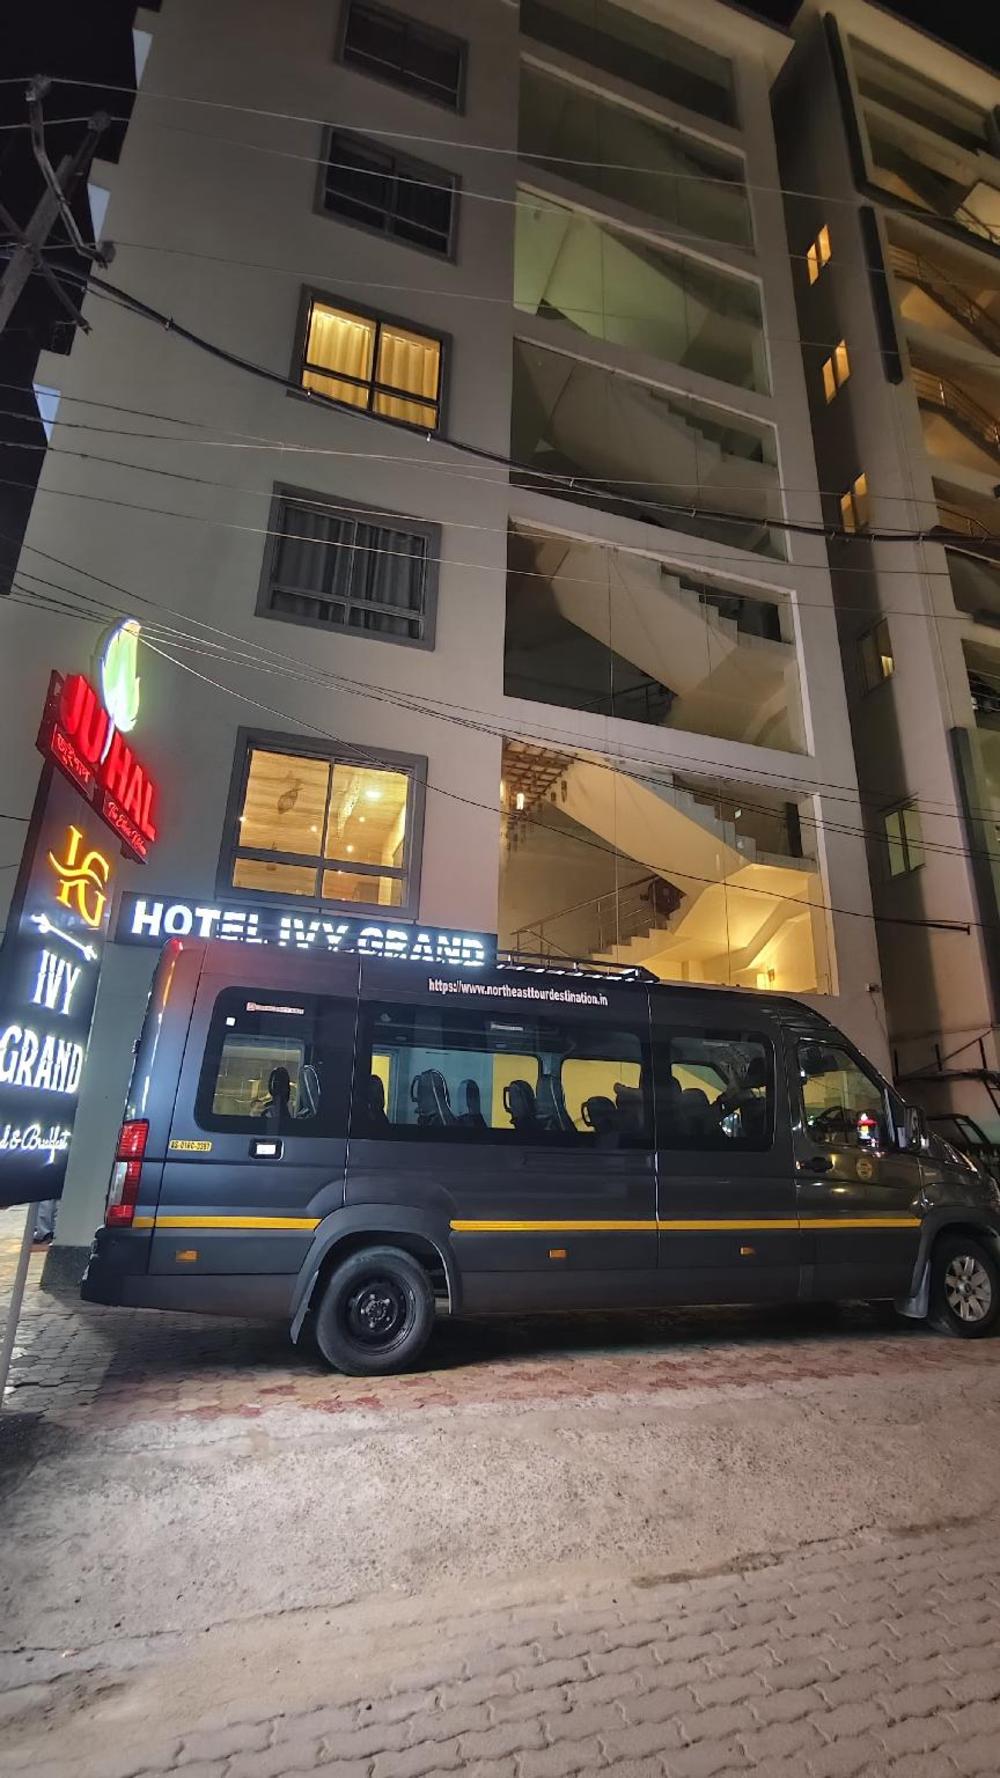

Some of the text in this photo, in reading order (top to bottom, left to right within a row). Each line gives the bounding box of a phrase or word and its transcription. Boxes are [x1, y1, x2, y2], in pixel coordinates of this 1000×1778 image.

[131, 900, 486, 967] HOTEL IVY GRAND
[32, 949, 81, 1015] IVY
[428, 977, 608, 1006] https://www.northeasttourdestination.in
[0, 1025, 83, 1094] GRAND
